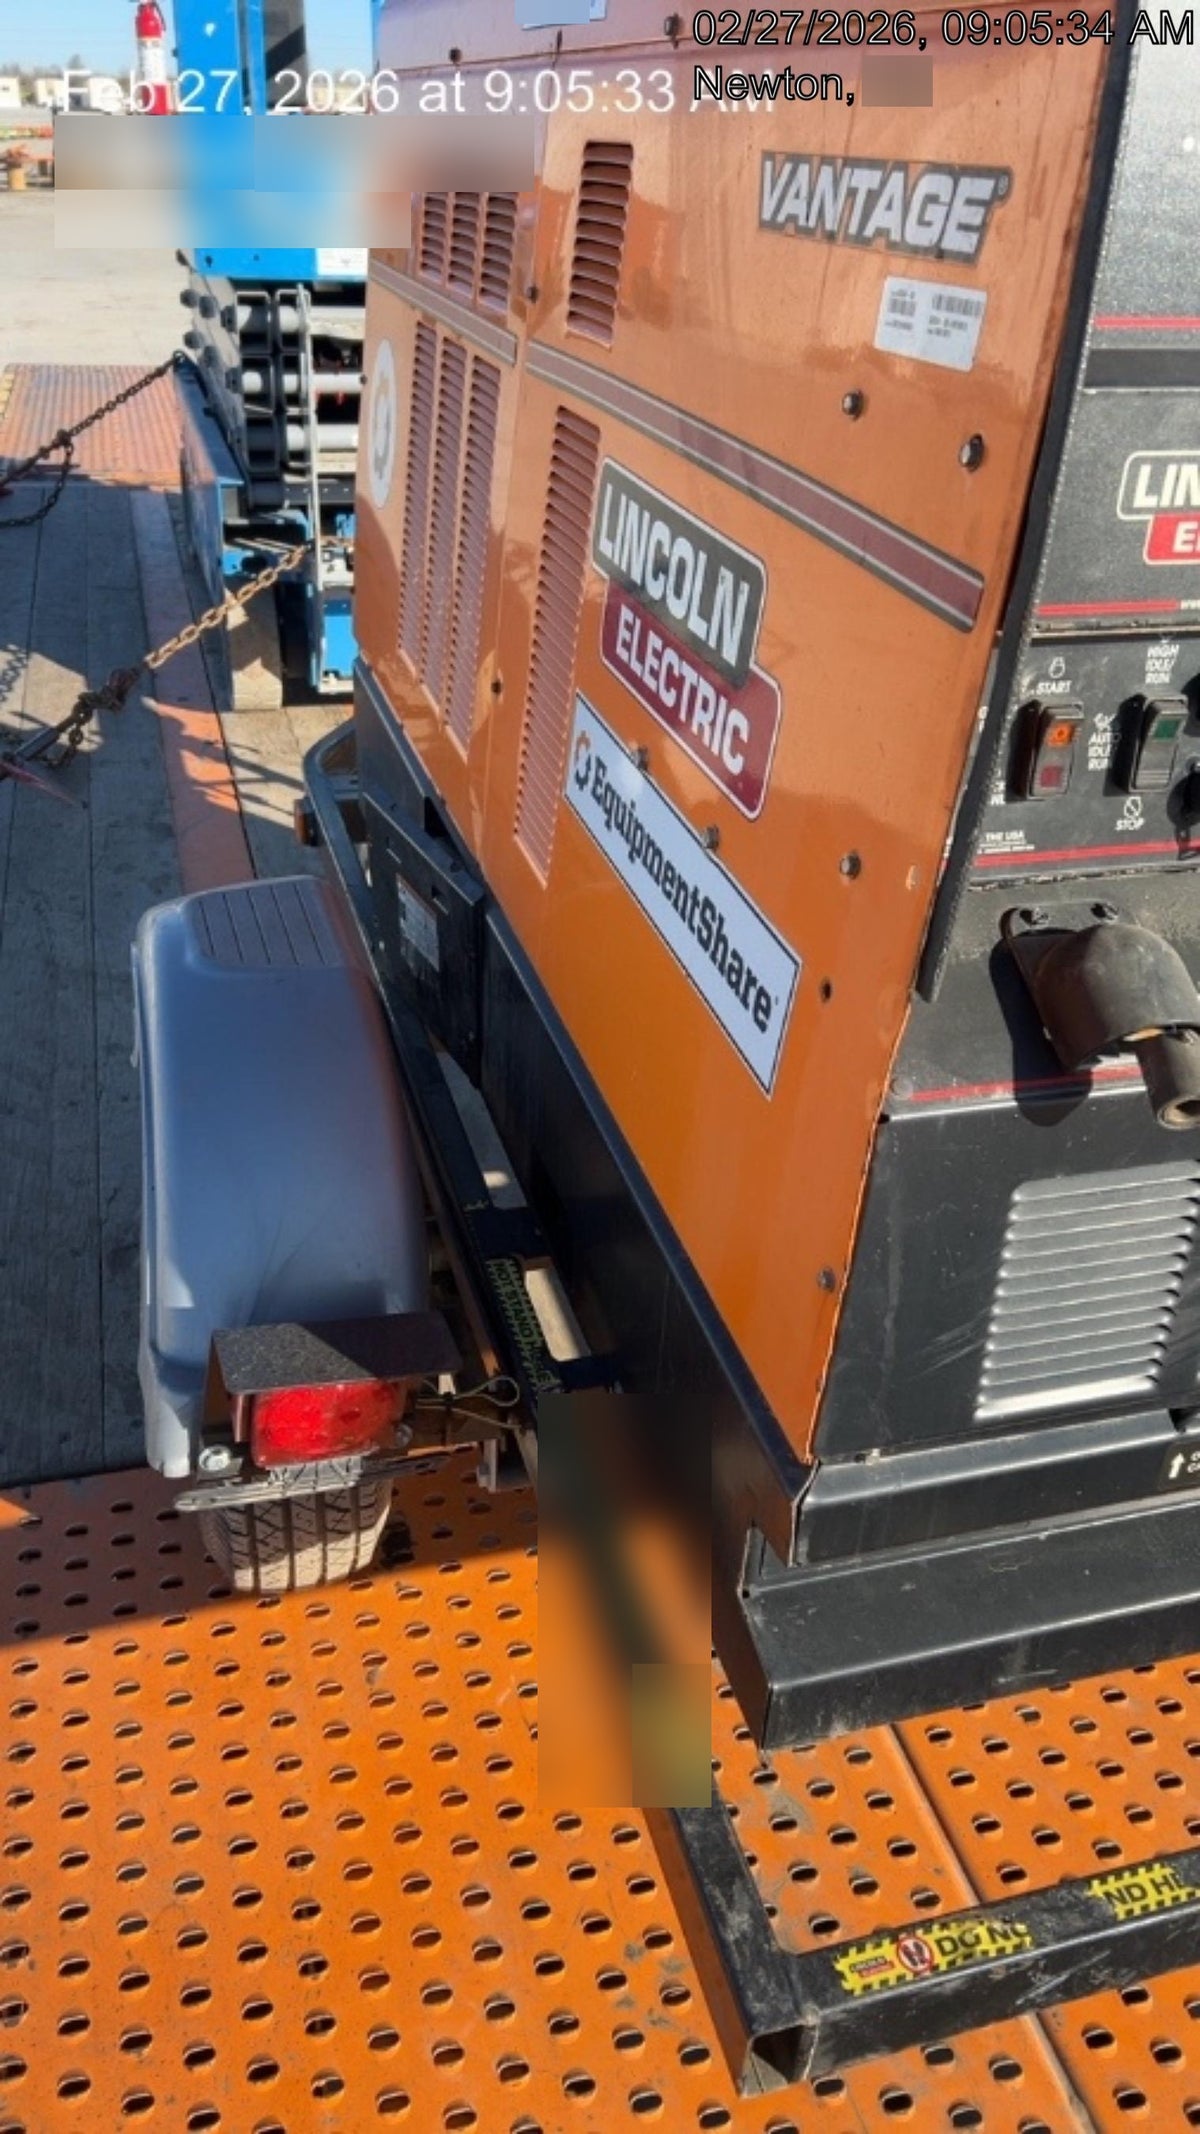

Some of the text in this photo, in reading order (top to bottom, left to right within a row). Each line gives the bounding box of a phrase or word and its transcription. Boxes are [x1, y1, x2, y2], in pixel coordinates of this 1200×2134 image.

[601, 483, 749, 668] LINCOLN
[616, 603, 749, 776] ELECTRIC
[1036, 680, 1072, 694] START
[590, 756, 774, 1034] EquipmentShare
[1115, 817, 1146, 832] STOP
